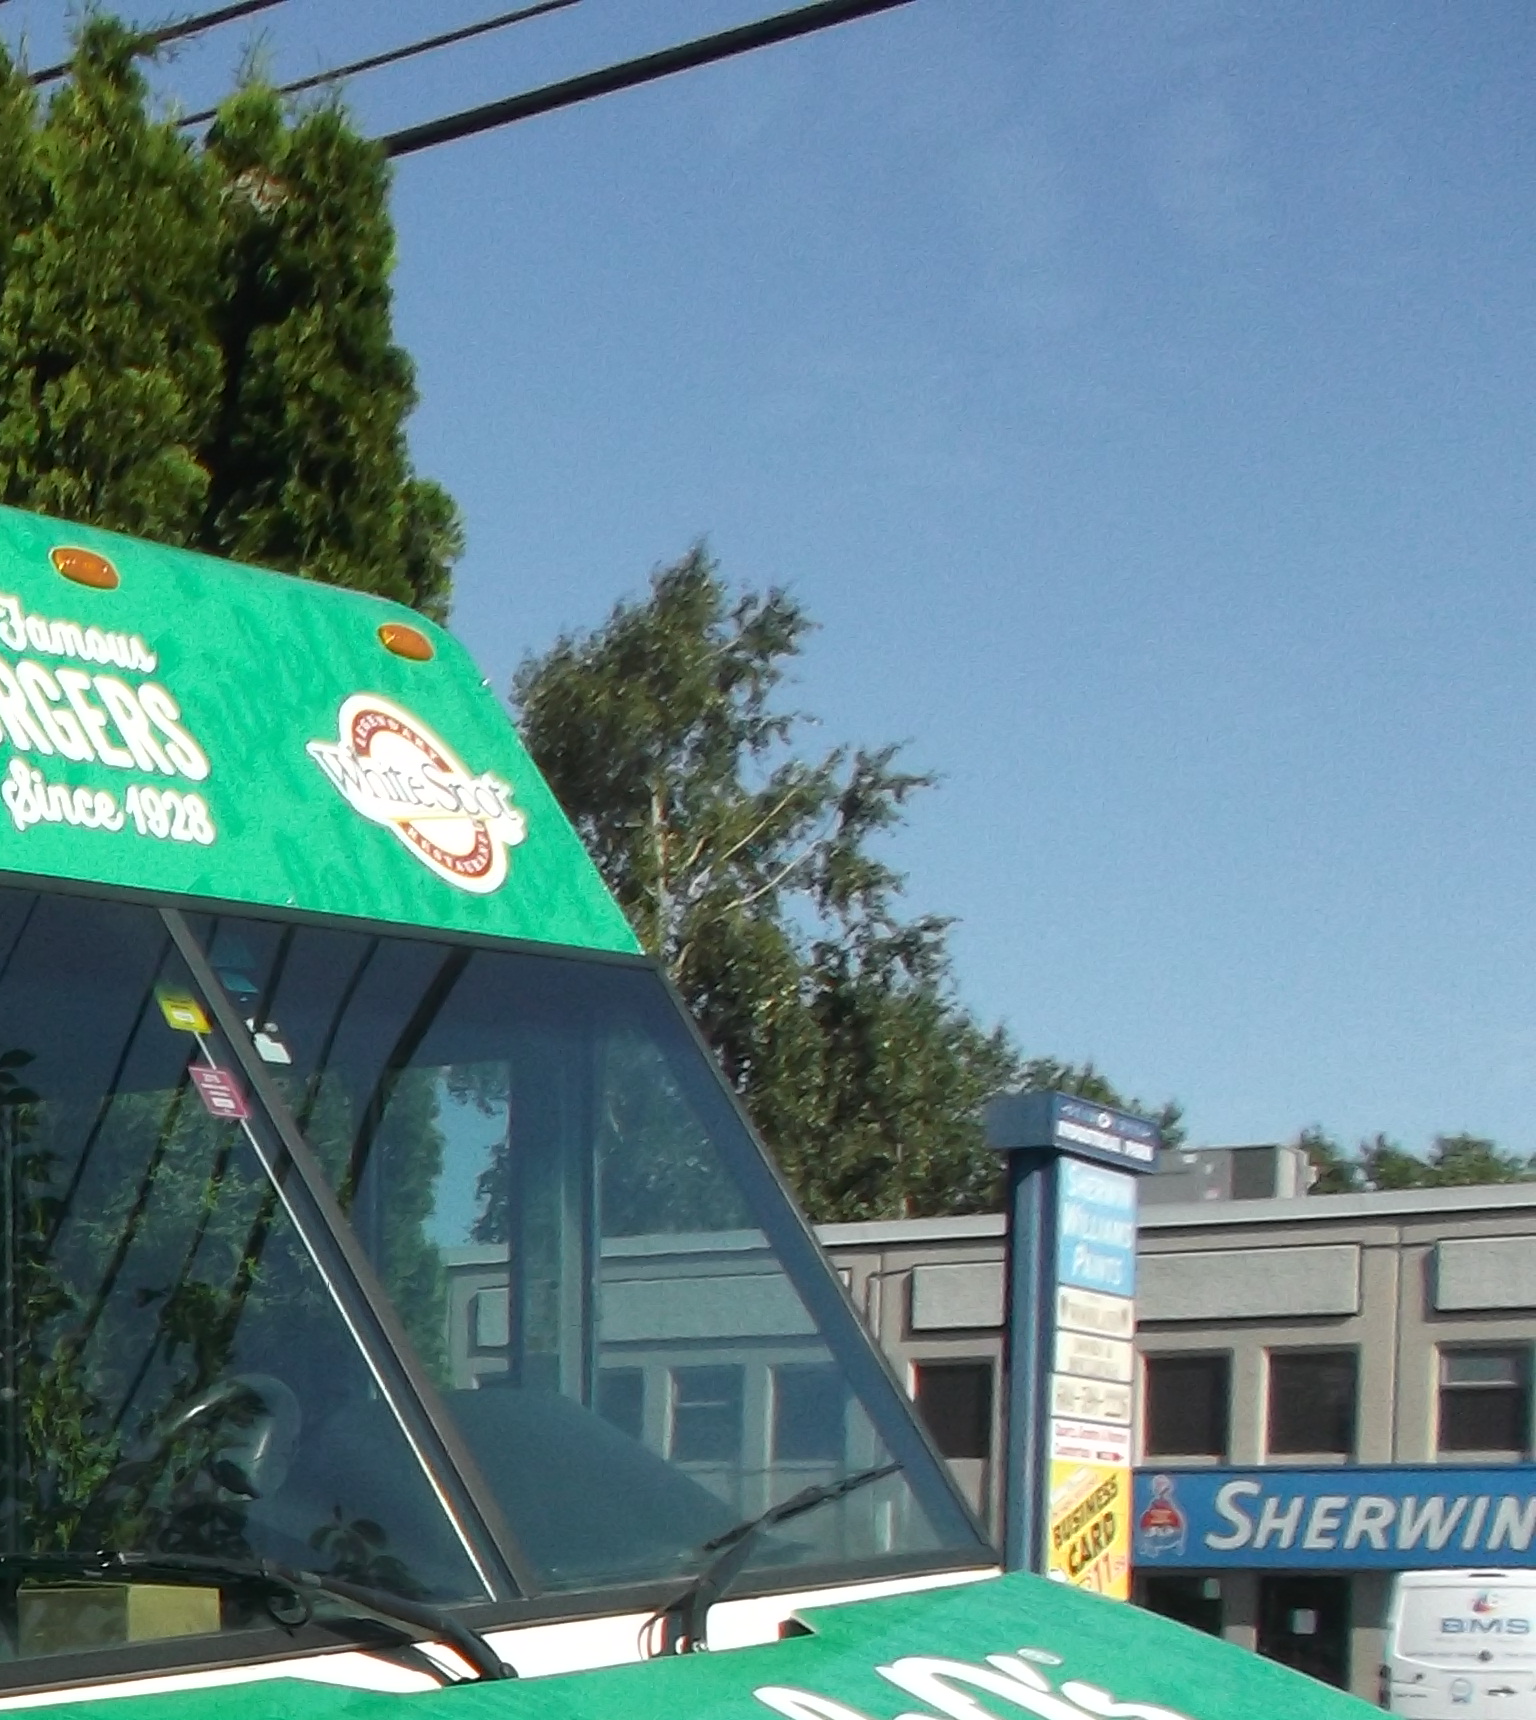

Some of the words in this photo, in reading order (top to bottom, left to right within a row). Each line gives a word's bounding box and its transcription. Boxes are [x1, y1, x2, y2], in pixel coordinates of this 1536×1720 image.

[2, 759, 124, 832] Since
[125, 784, 215, 846] 1928
[1069, 1511, 1115, 1577] CARD
[1204, 1480, 1536, 1550] SHERWIN
